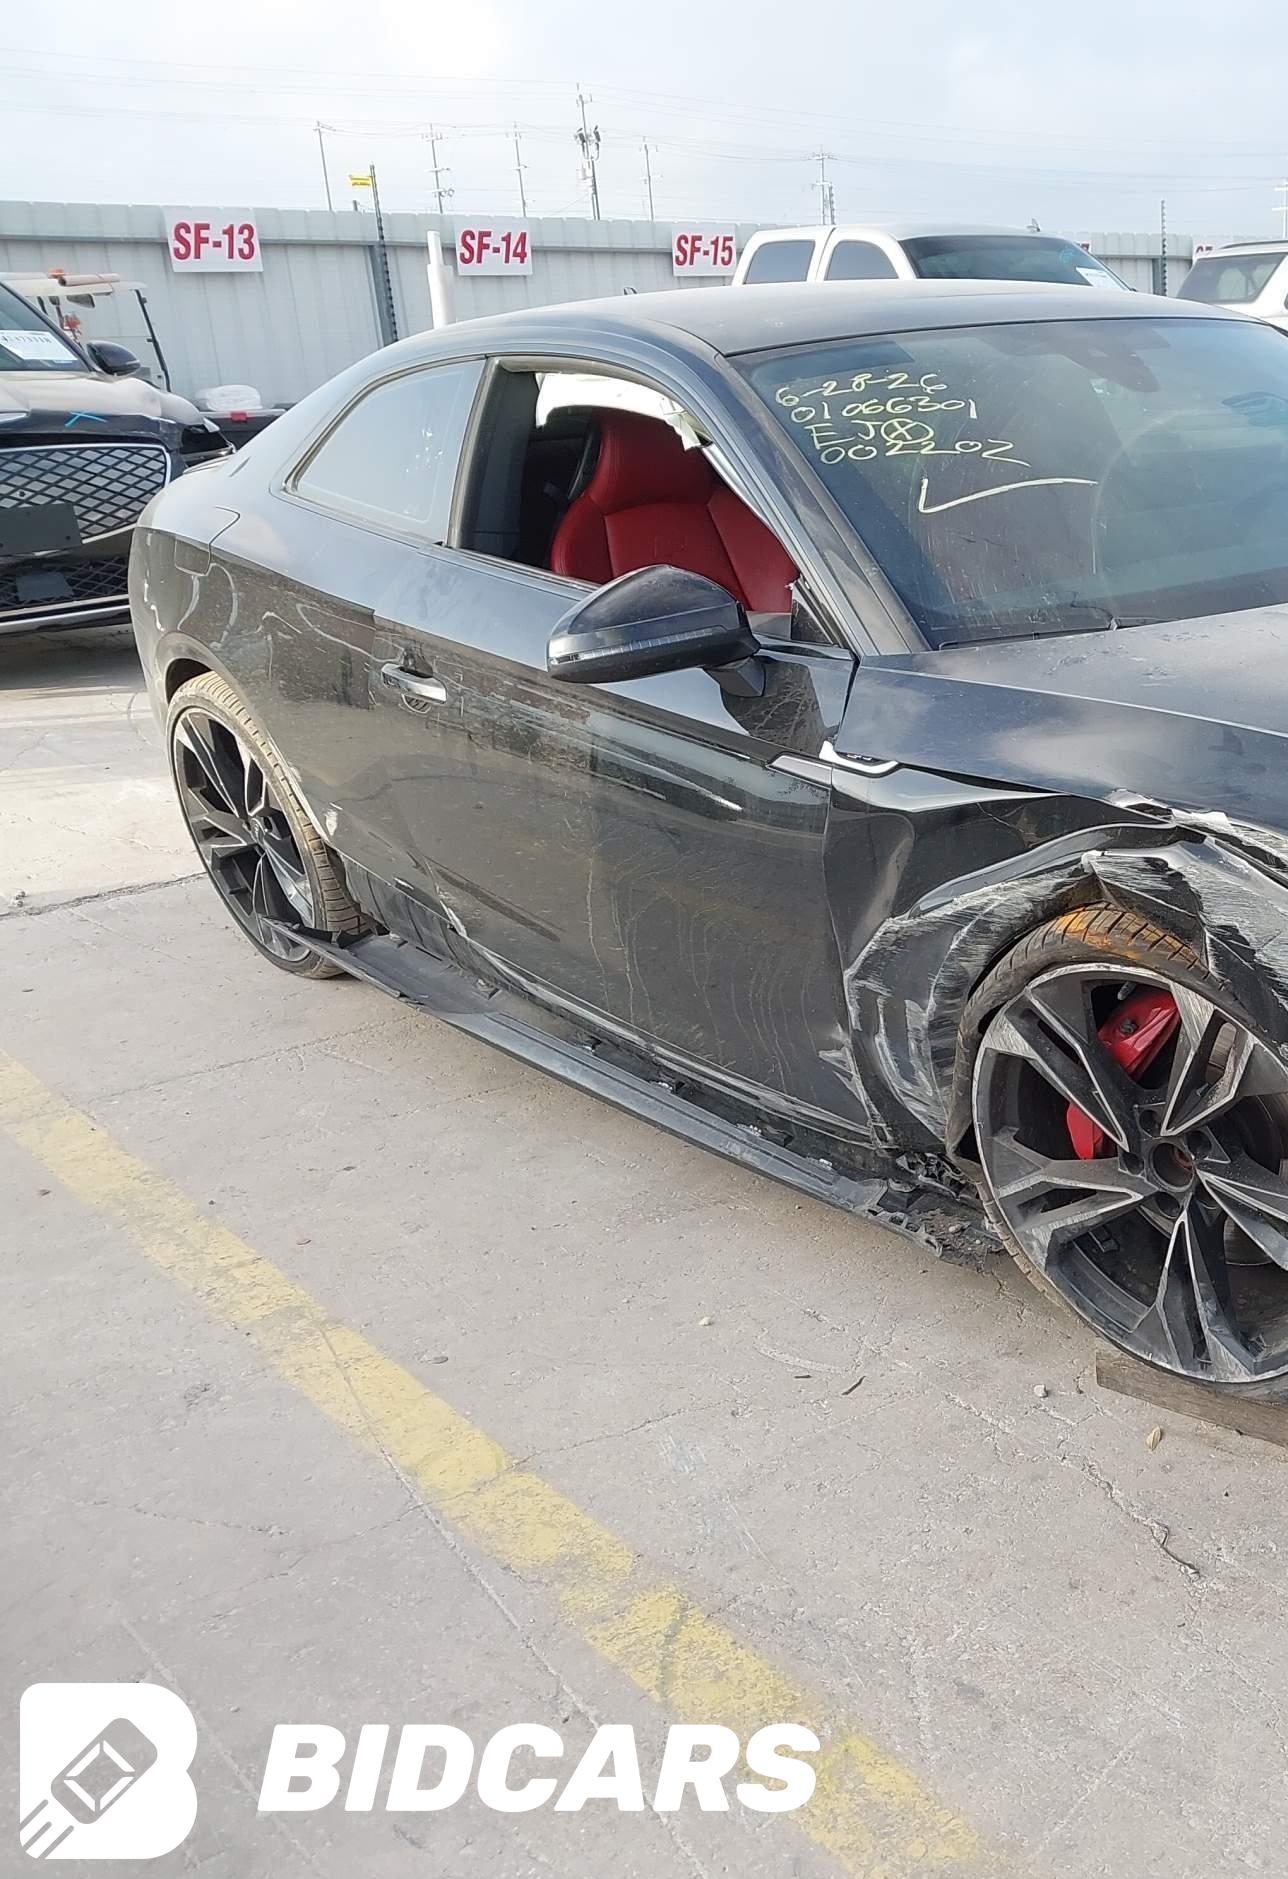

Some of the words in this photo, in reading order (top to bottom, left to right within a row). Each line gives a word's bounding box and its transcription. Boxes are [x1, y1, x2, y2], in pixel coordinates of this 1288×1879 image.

[173, 221, 255, 260] SF-13
[459, 229, 528, 264] SF-14
[674, 234, 734, 266] SF-15
